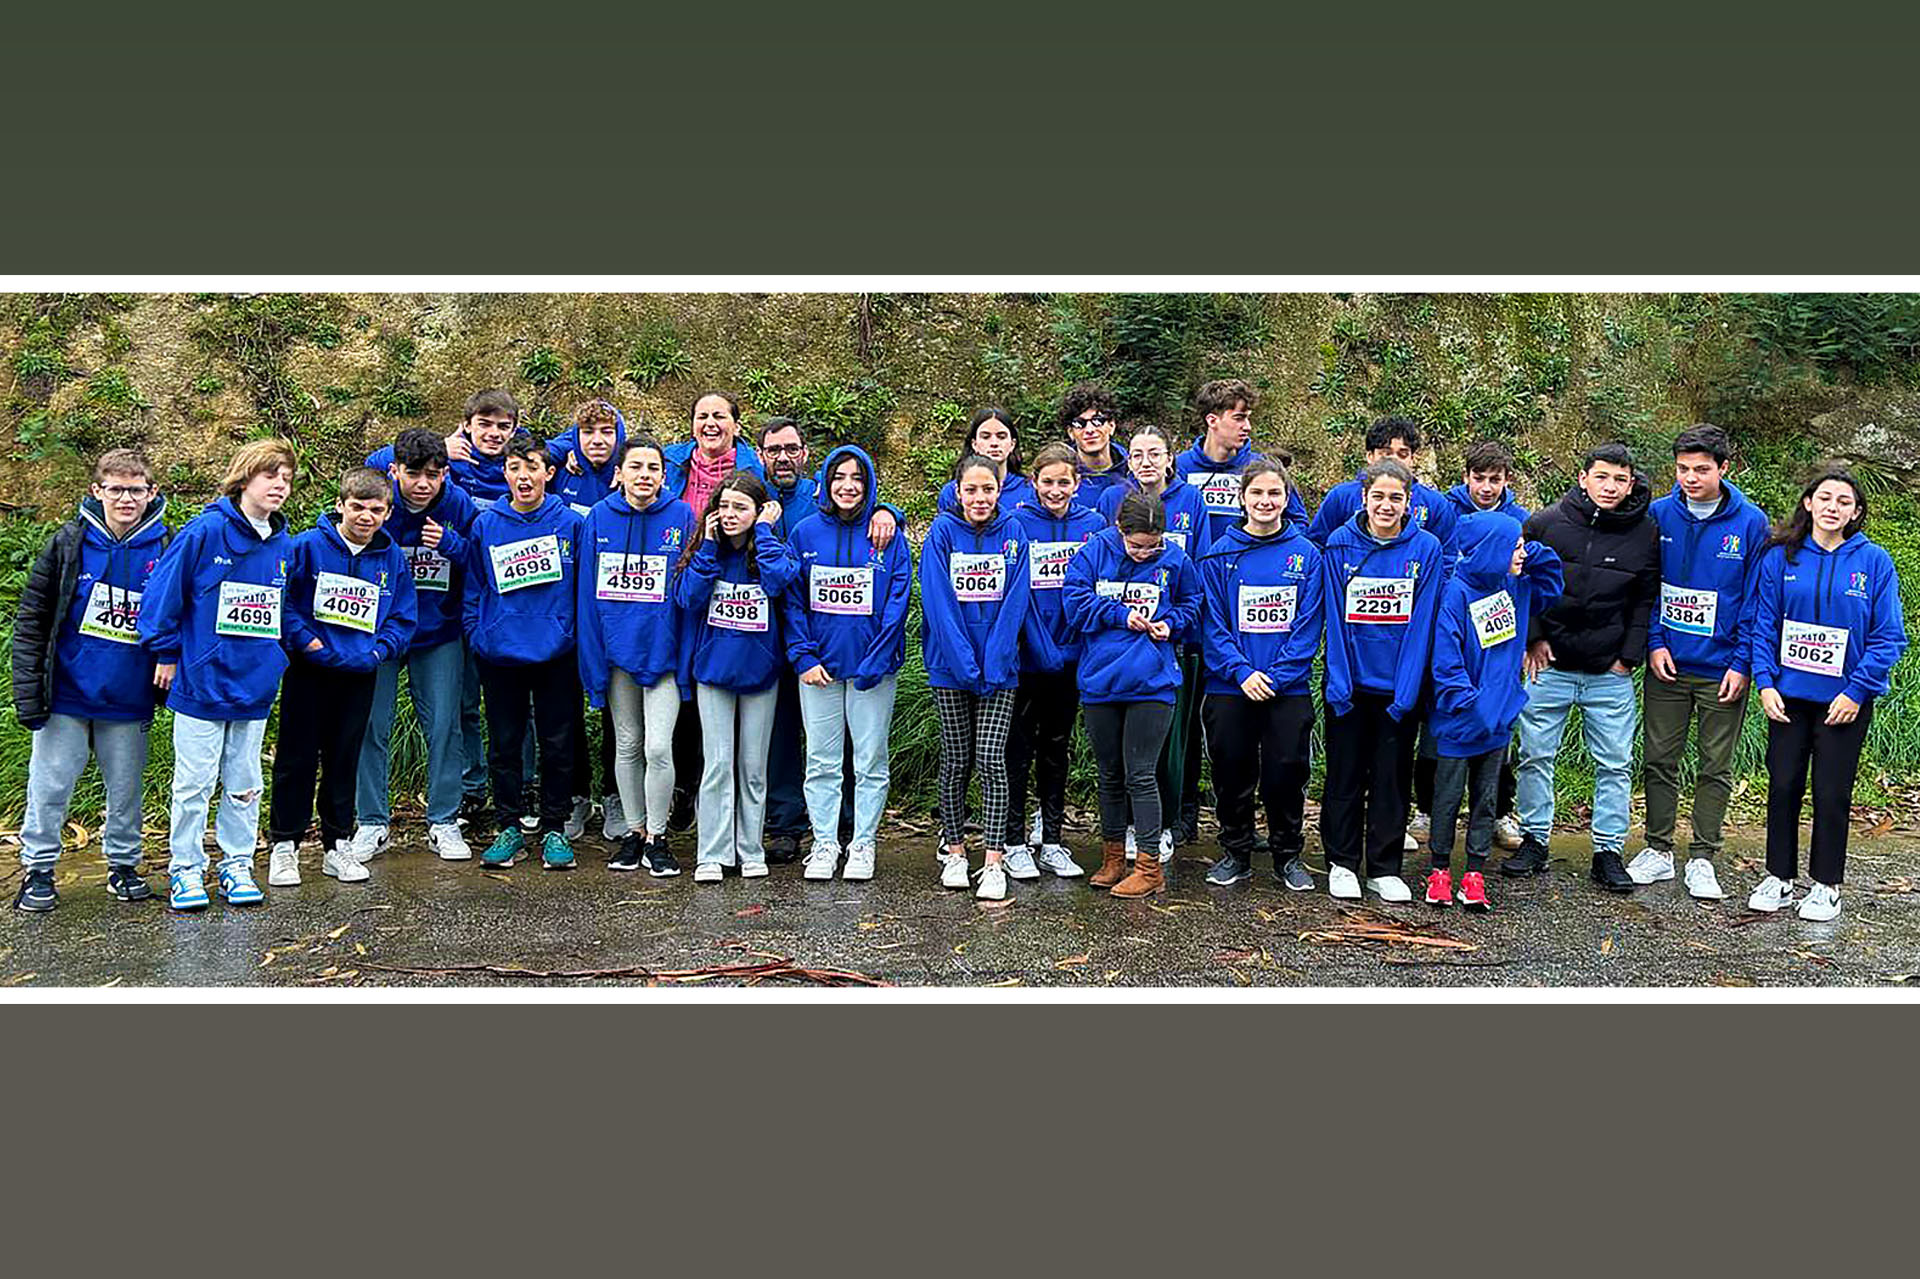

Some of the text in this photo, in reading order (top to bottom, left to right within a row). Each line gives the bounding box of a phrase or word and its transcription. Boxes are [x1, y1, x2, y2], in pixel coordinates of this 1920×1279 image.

[504, 558, 552, 579] 4698
[956, 577, 997, 591] 5064
[818, 588, 863, 604] 5065
[323, 597, 370, 618] 4097
[715, 603, 758, 620] 4398
[1247, 608, 1288, 622] 5063
[1356, 599, 1401, 614] 2291
[1666, 605, 1705, 624] 5384
[227, 607, 271, 626] 4699
[1788, 644, 1833, 664] 5062
